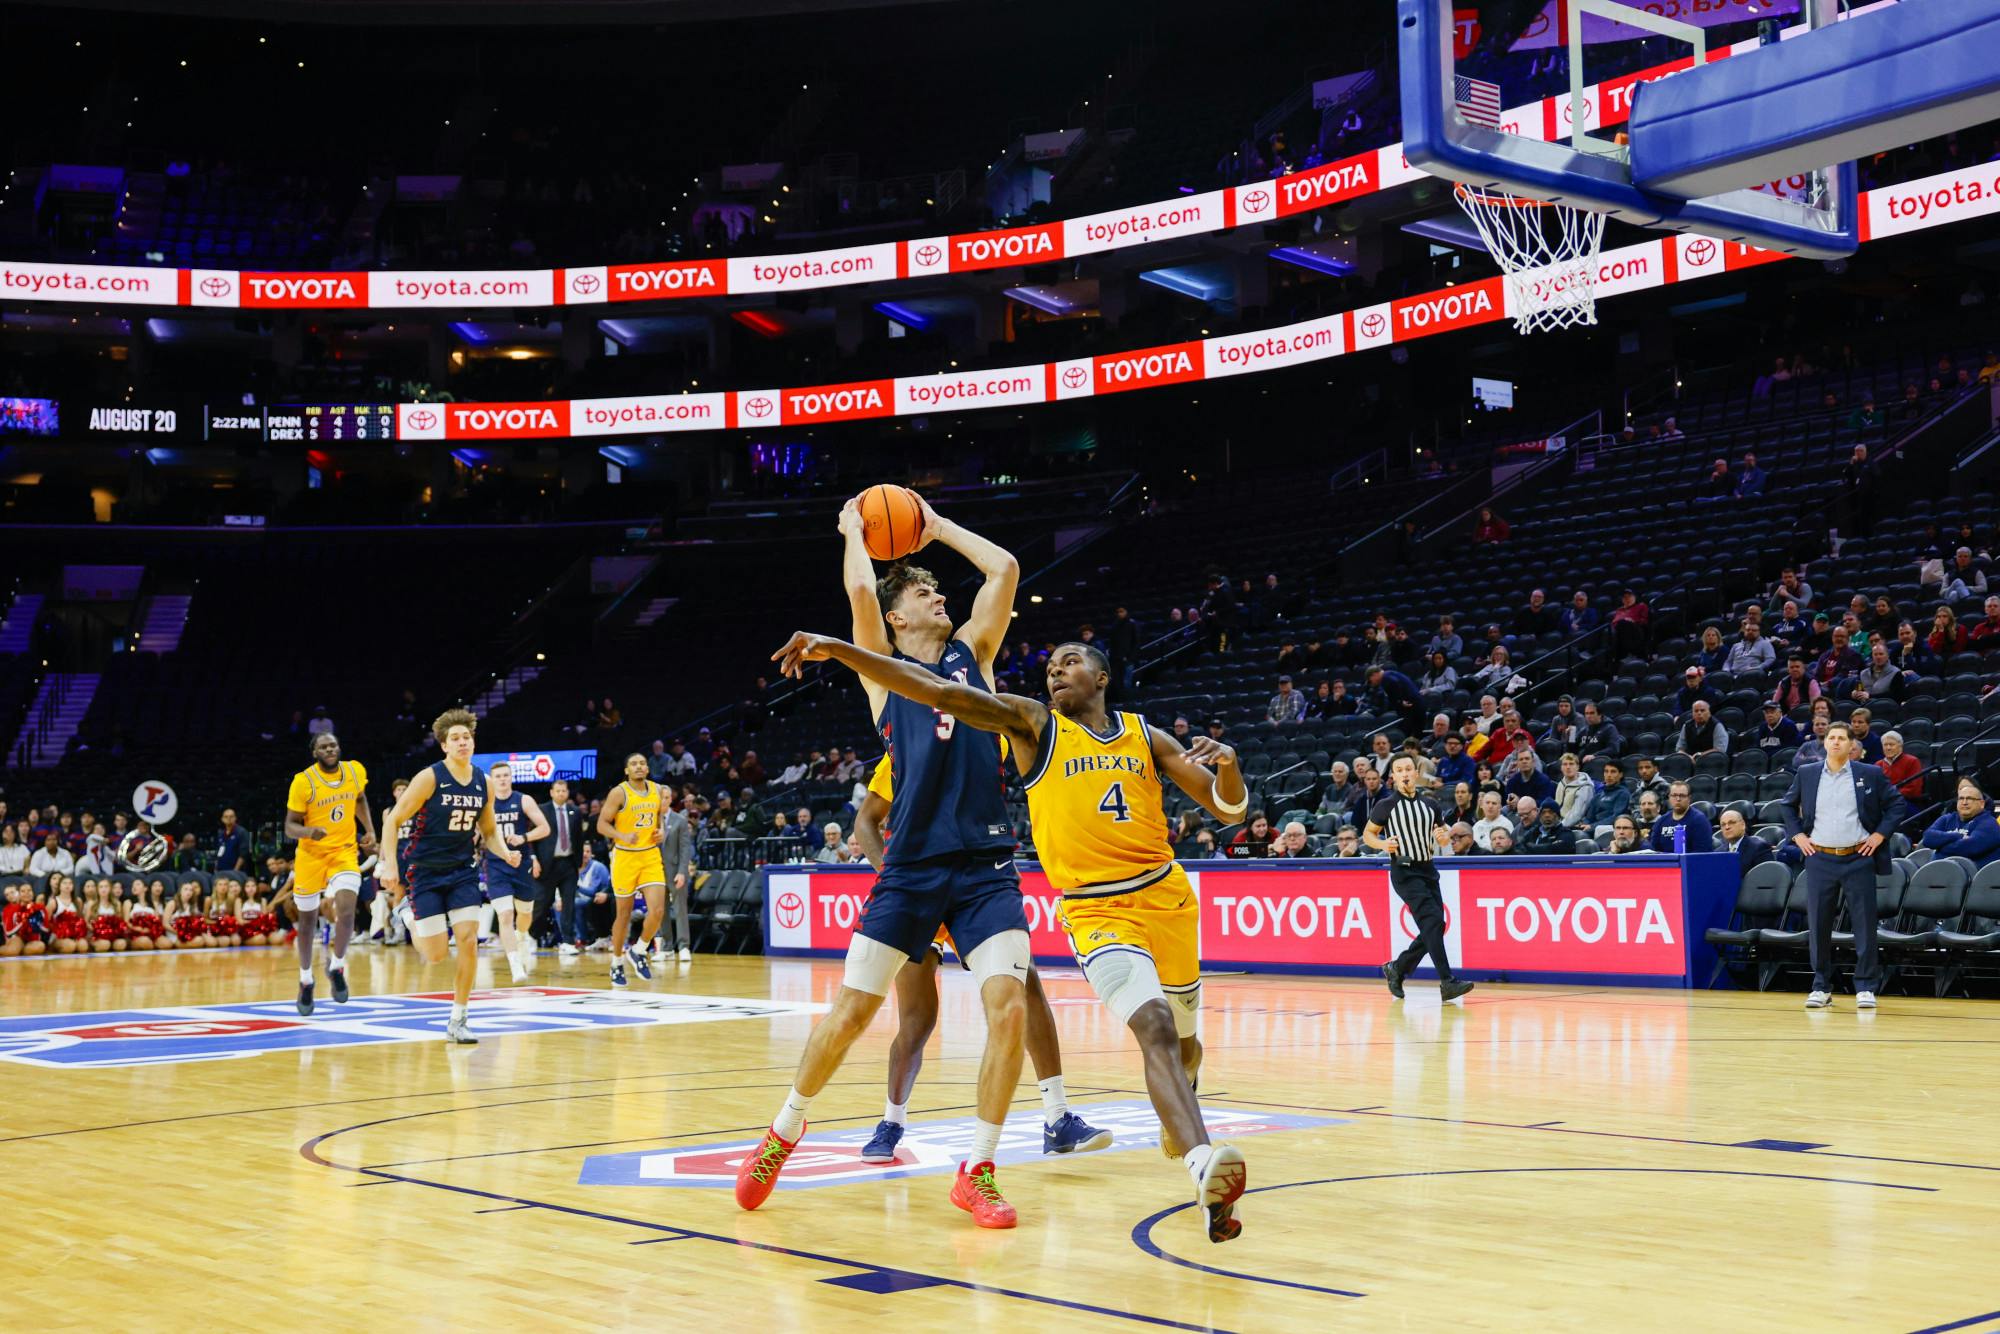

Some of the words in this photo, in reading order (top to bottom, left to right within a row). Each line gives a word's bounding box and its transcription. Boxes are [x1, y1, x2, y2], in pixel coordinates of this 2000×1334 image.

[1284, 163, 1368, 205] TOYOTA
[1086, 206, 1201, 242] toyota.com
[957, 232, 1053, 262] TOYOTA
[4, 271, 150, 293] toyota.com
[615, 267, 715, 292] TOYOTA
[753, 256, 874, 285] toyota.com
[249, 279, 355, 299] TOYOTA
[395, 279, 529, 298] toyota.com
[1399, 290, 1492, 328] TOYOTA
[1217, 329, 1332, 367] toyota.com
[1101, 351, 1193, 383] TOYOTA
[789, 388, 883, 415] TOYOTA
[908, 377, 1032, 405] toyota.com
[89, 408, 152, 431] AUGUST
[155, 410, 176, 432] 20
[212, 417, 238, 428] 2:22
[240, 418, 261, 428] PM
[268, 416, 301, 428] PENN
[310, 416, 319, 427] 6
[334, 416, 343, 427] 4
[357, 416, 366, 427] 0
[381, 416, 390, 427] 0
[454, 408, 558, 430] TOYOTA
[585, 402, 711, 430] toyota.com
[270, 428, 304, 440] DREX
[310, 428, 318, 439] 5
[334, 428, 342, 439] 3
[357, 428, 366, 439] 0
[381, 428, 389, 439] 3
[1064, 755, 1147, 780] DREXEL
[330, 804, 345, 823] 6
[441, 793, 483, 809] PENN
[1098, 781, 1132, 823] 4
[448, 810, 477, 831] 25
[495, 811, 519, 823] ENN
[634, 812, 654, 828] 23
[1213, 895, 1373, 939] TOYOTA
[1476, 896, 1675, 945] TOYOTA
